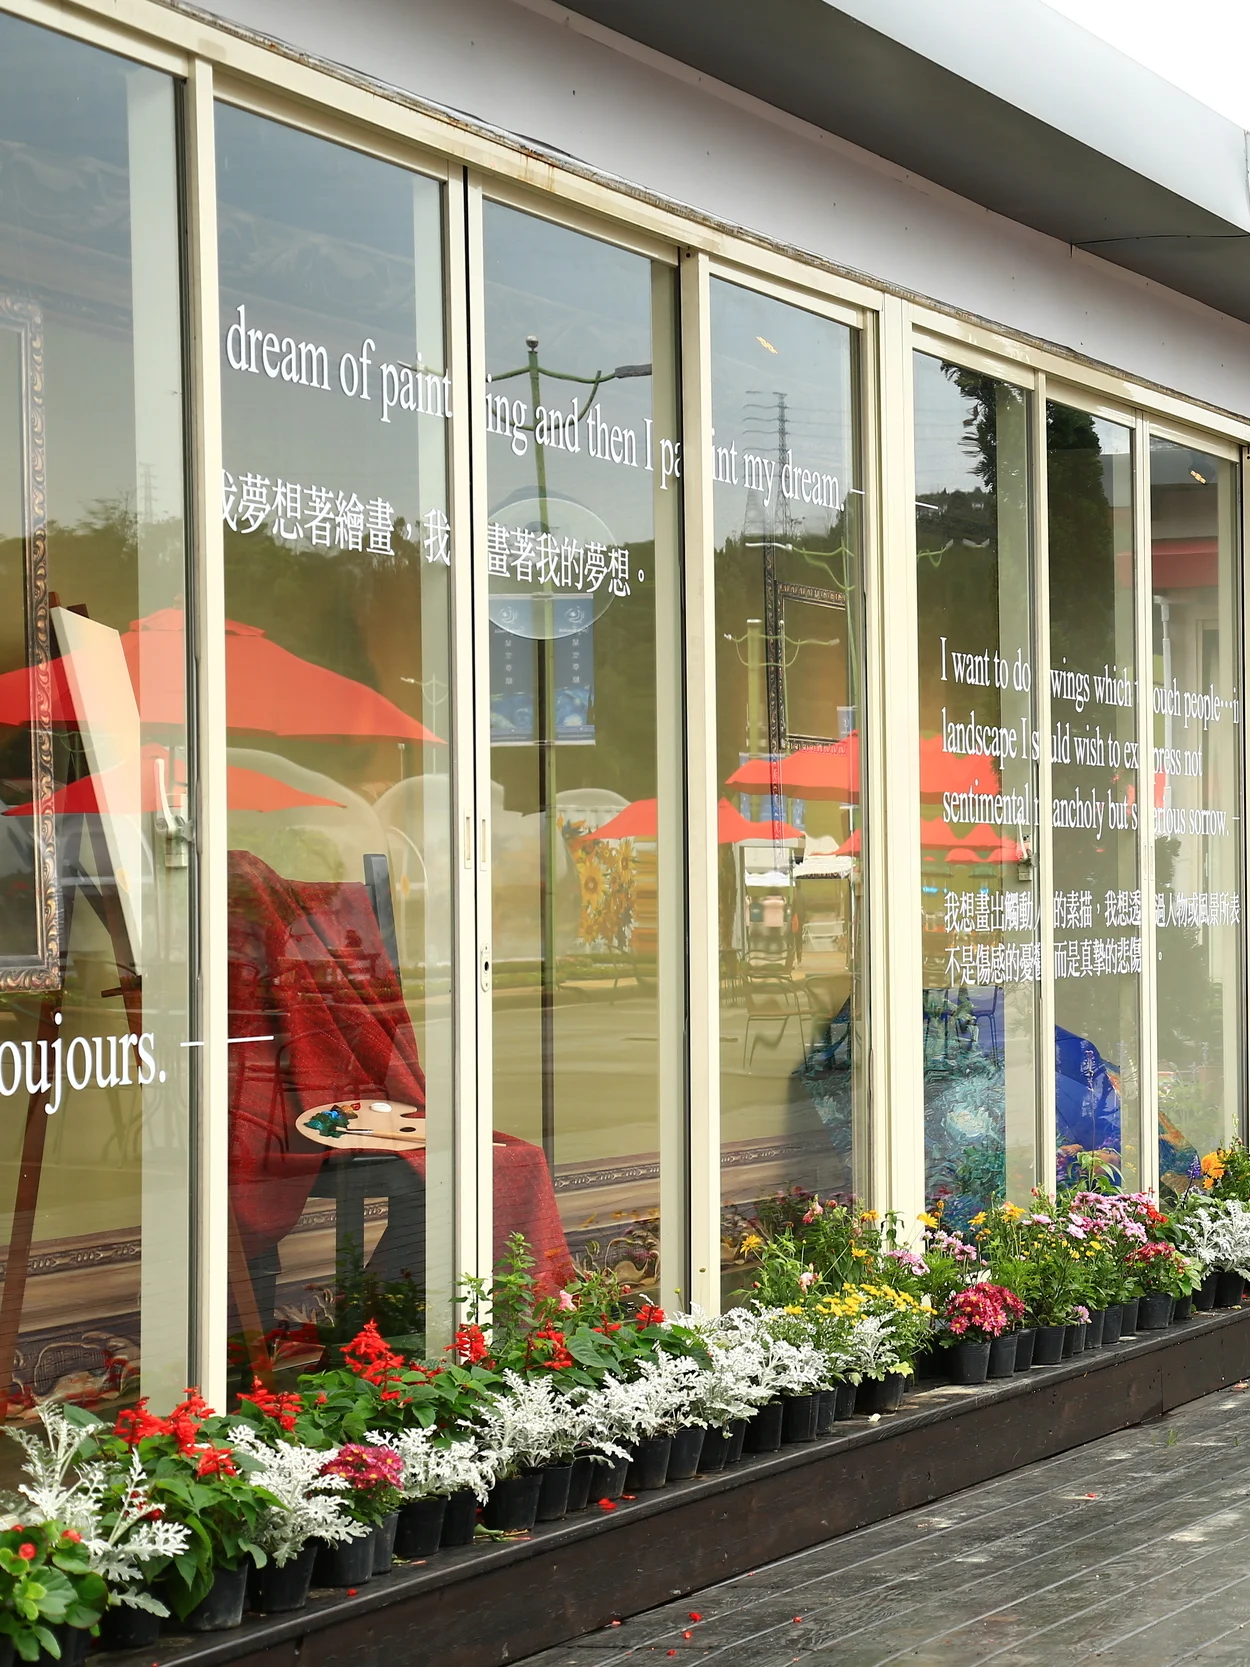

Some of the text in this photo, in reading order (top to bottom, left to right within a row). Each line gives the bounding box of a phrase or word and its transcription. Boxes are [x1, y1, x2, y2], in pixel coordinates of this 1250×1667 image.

[227, 304, 332, 391] dream
[339, 338, 376, 400] of
[535, 396, 581, 454] and
[586, 402, 638, 467] then
[643, 418, 654, 471] I
[743, 453, 776, 507] my
[940, 636, 948, 681] I
[951, 648, 991, 687] want
[993, 650, 1009, 690] to
[1013, 648, 1032, 692] do
[1093, 664, 1132, 708] which
[941, 707, 1018, 770] landscape
[1020, 717, 1028, 760] I
[1073, 724, 1106, 767] wish
[1107, 732, 1121, 769] to
[1183, 745, 1204, 778] not
[943, 778, 1031, 826] sentimental
[1107, 788, 1128, 831] but
[1189, 808, 1229, 837] sorrow.
